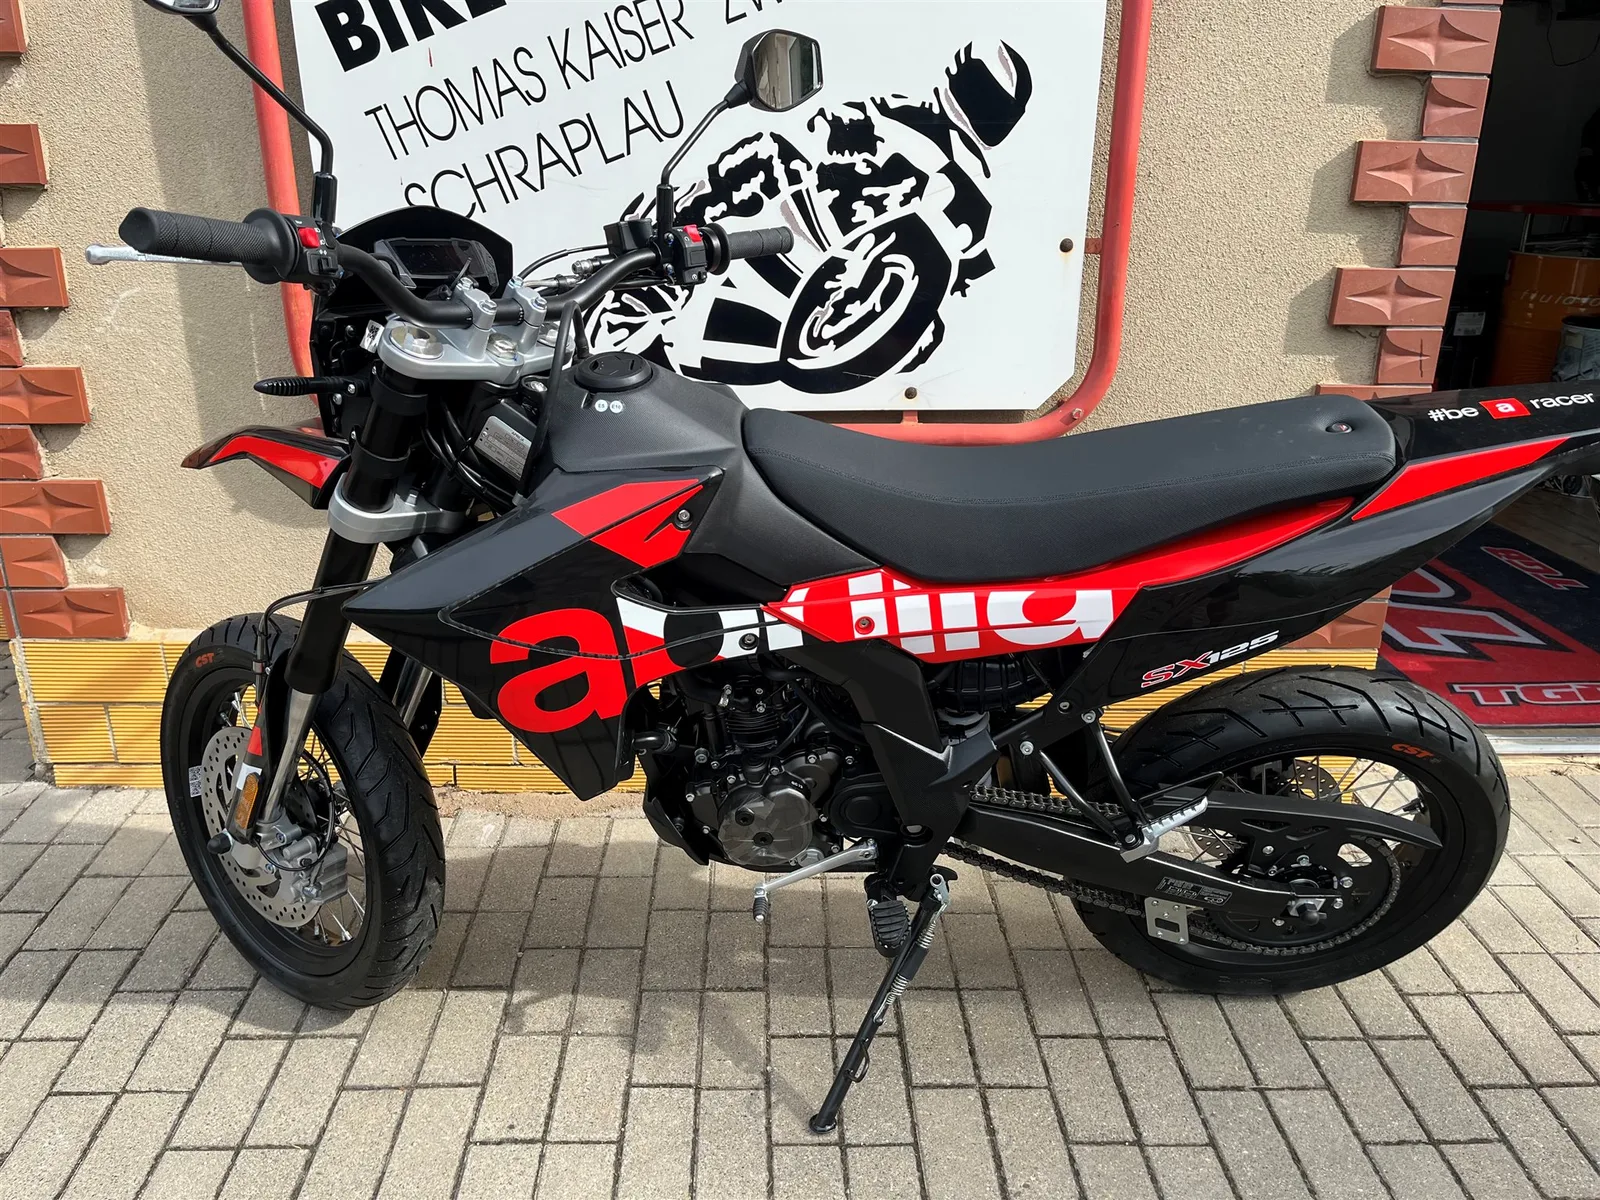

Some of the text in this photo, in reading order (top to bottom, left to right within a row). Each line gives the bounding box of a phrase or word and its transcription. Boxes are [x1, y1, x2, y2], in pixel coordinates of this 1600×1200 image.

[315, 0, 507, 72] BIK
[364, 0, 694, 160] THOMAS KAISER
[1427, 406, 1479, 422] #be
[1530, 392, 1595, 409] racer
[195, 652, 215, 668] CST
[1392, 743, 1434, 758] CST
